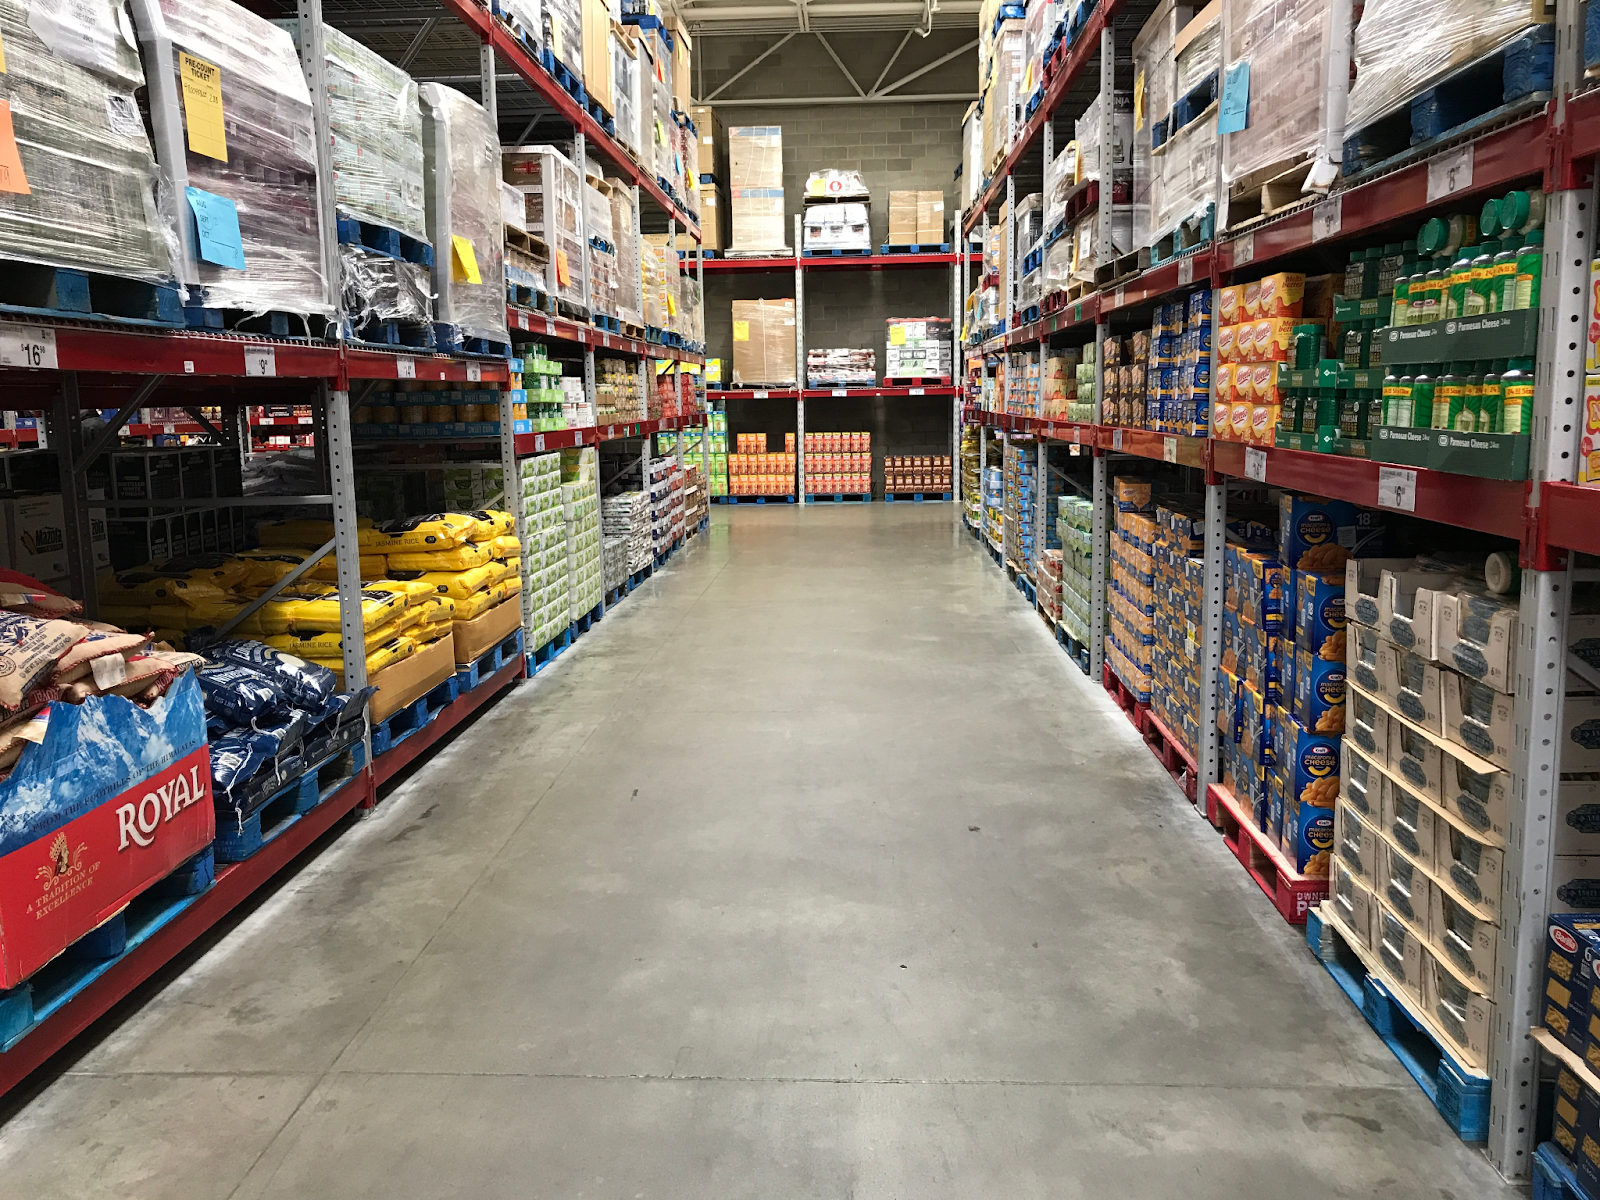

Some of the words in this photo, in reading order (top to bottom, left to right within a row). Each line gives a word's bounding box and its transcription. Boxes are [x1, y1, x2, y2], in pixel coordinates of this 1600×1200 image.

[185, 57, 215, 76] PRE-COUNT
[191, 68, 210, 82] TICKET
[1113, 96, 1131, 108] NJA
[195, 199, 207, 209] AUG
[199, 214, 209, 224] SEPT
[201, 230, 210, 239] OCT
[1282, 281, 1303, 289] better
[1458, 321, 1482, 332] Parmesan
[1482, 318, 1500, 328] Cheese
[1400, 331, 1417, 340] Parmesan
[1417, 329, 1431, 338] Cheese
[468, 426, 482, 434] SWEET
[482, 425, 494, 433] CORN
[1389, 432, 1407, 441] Parmesan
[1407, 433, 1422, 441] Cheese
[1449, 437, 1471, 447] Parmesan
[1470, 438, 1489, 449] Cheese
[1356, 512, 1371, 526] 18
[91, 521, 104, 537] zola
[35, 526, 62, 548] Mazola
[375, 539, 403, 549] JASMINE
[404, 537, 420, 546] RICE
[289, 642, 318, 650] JASMINE
[318, 641, 334, 649] RICE
[32, 813, 61, 833] FROM
[64, 802, 82, 818] THE
[84, 776, 131, 806] FOOTHILLS
[132, 771, 143, 780] OF
[144, 759, 160, 772] THE
[160, 739, 197, 764] HIMALAYAS
[115, 765, 205, 852] ROYAL
[26, 903, 34, 915] A
[35, 872, 86, 908] TRADITION
[88, 861, 101, 874] OF
[35, 876, 94, 922] EXCELLENCE
[1555, 931, 1576, 949] Barilla
[1584, 946, 1592, 962] 6
